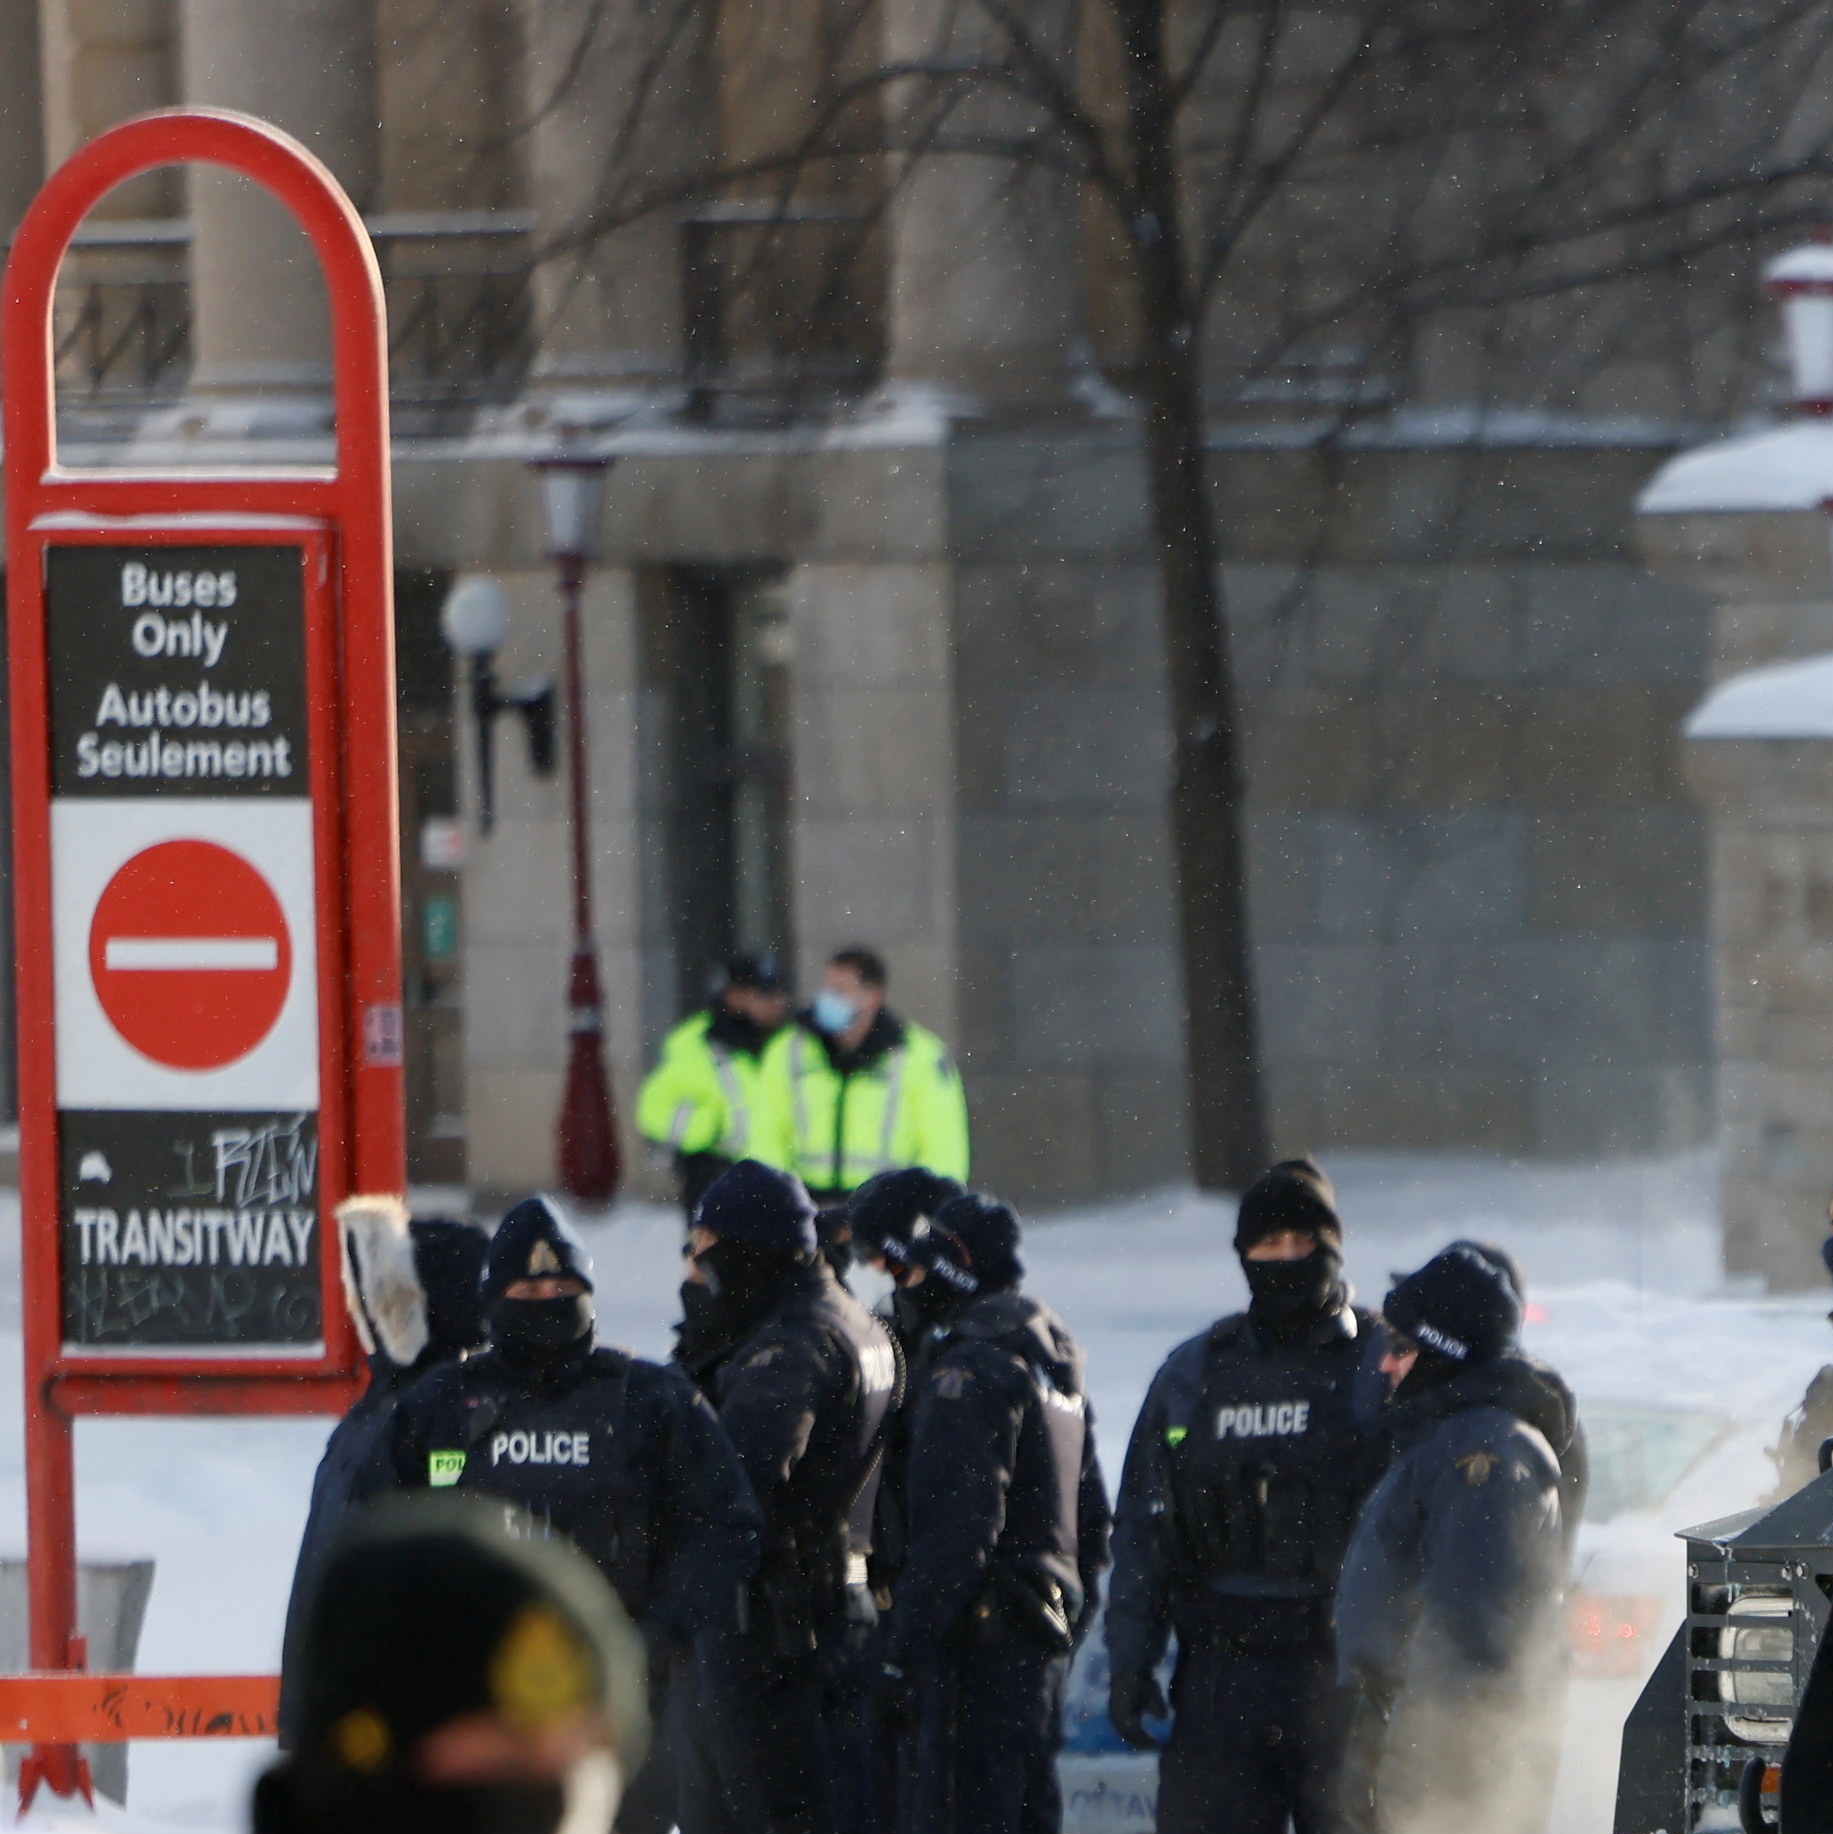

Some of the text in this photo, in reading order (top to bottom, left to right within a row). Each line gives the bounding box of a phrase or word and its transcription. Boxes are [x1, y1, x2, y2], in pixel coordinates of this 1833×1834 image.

[121, 561, 237, 608] Buses
[131, 609, 229, 668] Only
[95, 680, 271, 728] Autobus
[76, 730, 292, 778] Seulement
[74, 1206, 315, 1267] TRANSITWAY
[1416, 1322, 1470, 1360] POLICE
[1217, 1400, 1311, 1440] POLICE
[491, 1429, 592, 1467] POLICE
